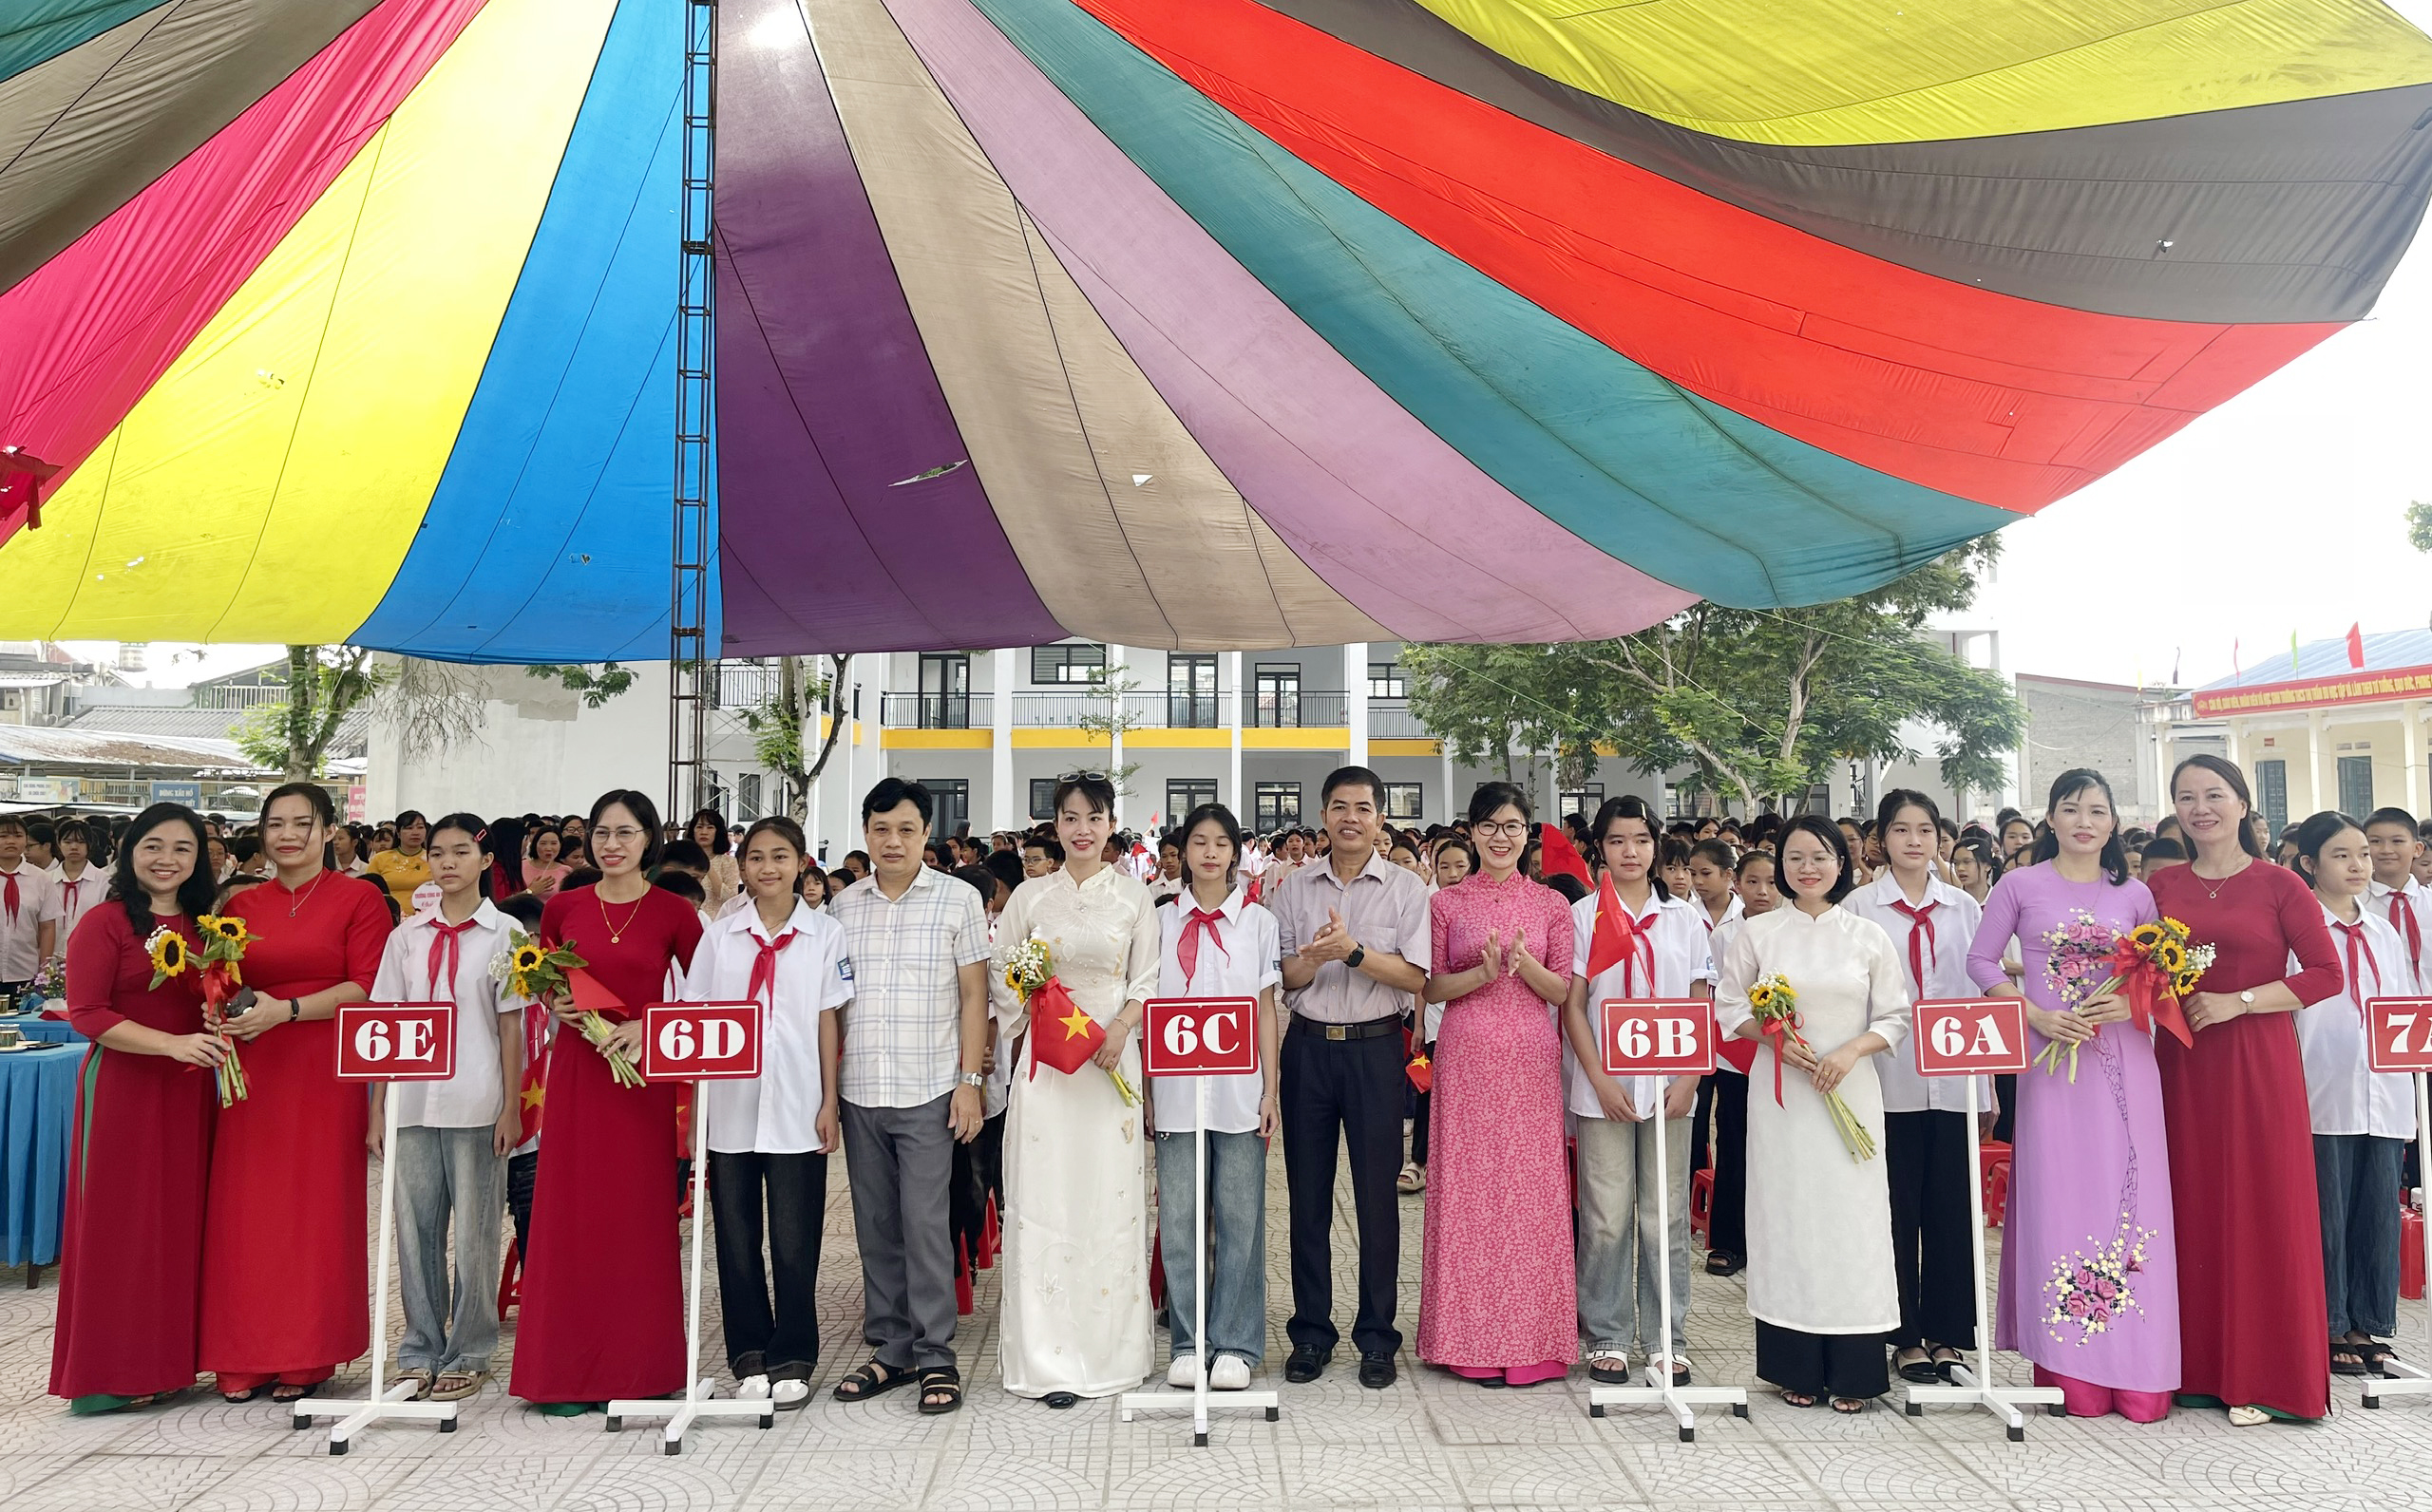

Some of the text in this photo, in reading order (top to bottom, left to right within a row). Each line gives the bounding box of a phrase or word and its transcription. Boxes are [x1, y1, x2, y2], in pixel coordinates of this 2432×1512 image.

[355, 1018, 435, 1062] 6E
[659, 1019, 745, 1060] 6D
[1165, 1011, 1239, 1055] 6C
[1618, 1018, 1697, 1058] 6B
[1931, 1013, 2011, 1056] 6A
